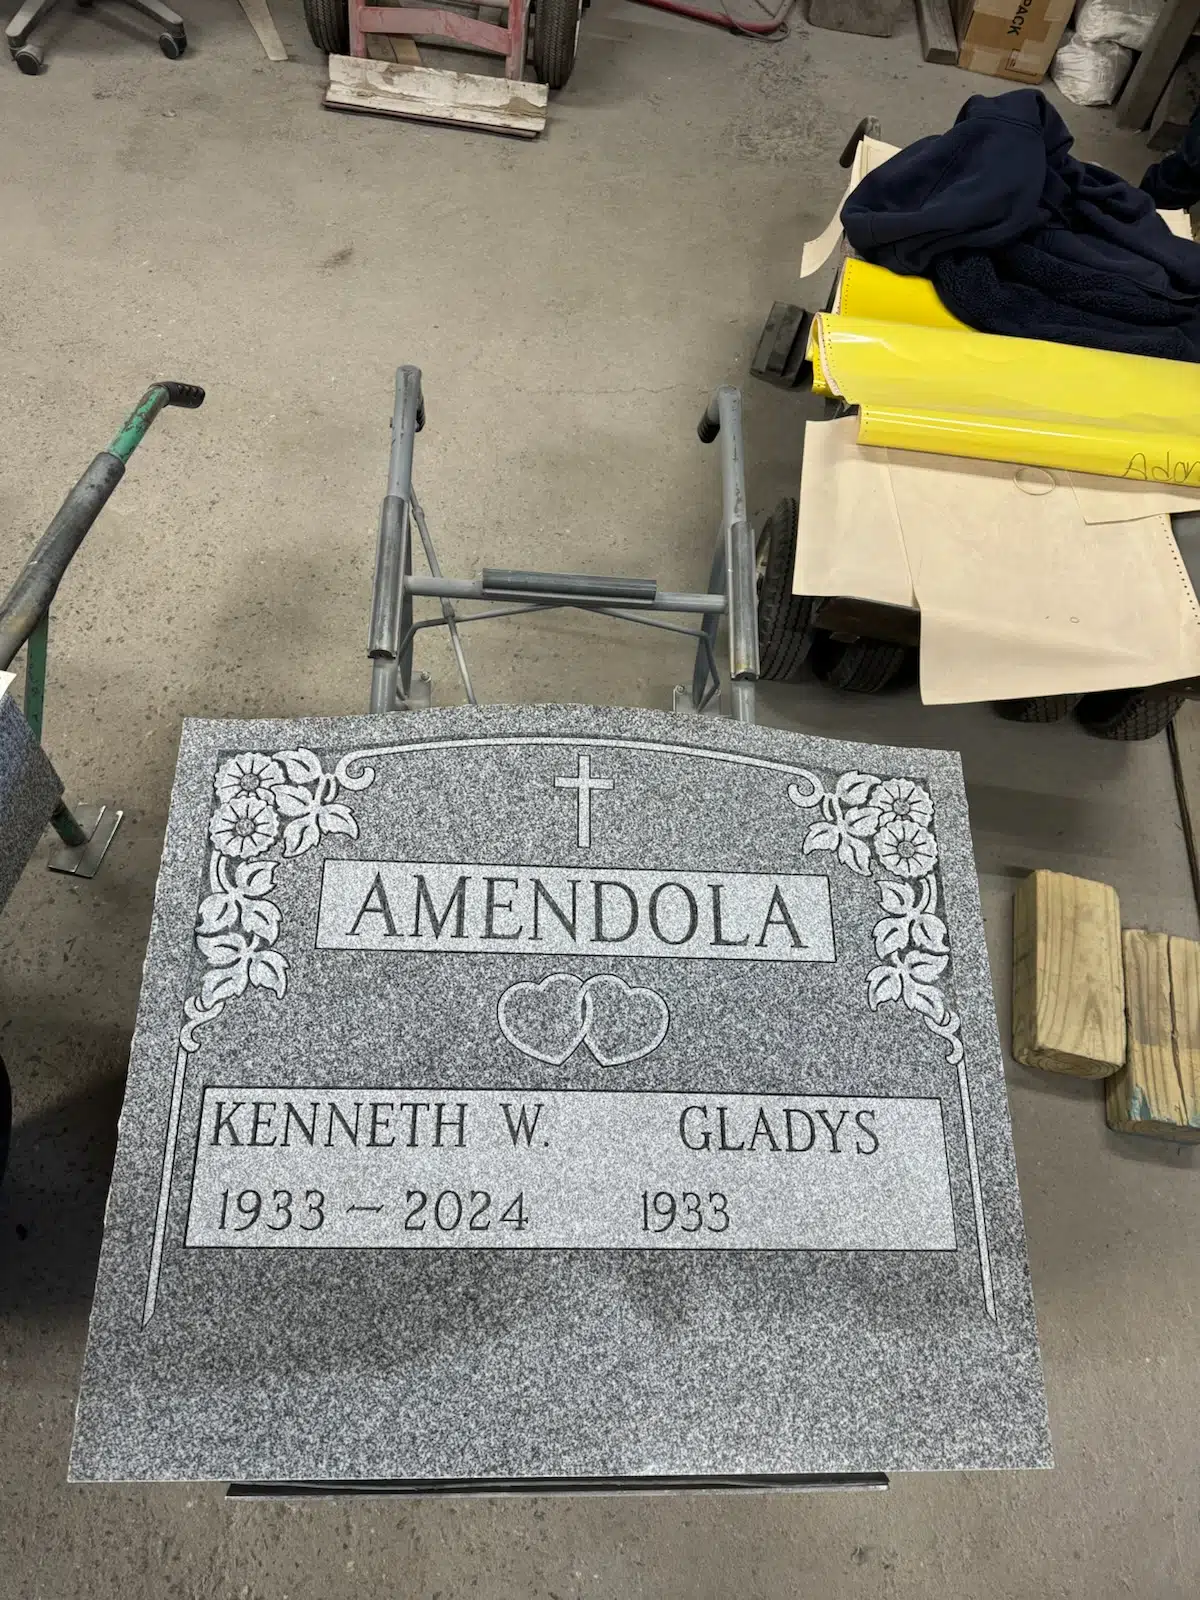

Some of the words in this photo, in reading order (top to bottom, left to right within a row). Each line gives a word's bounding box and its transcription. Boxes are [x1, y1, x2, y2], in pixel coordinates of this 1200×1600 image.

[346, 871, 808, 948] AMENDOLA
[210, 1101, 468, 1147] KENNETH
[500, 1103, 550, 1148] W.
[679, 1105, 880, 1155] GLADYS
[217, 1188, 326, 1232] 1933
[404, 1190, 529, 1232] 2024
[641, 1190, 731, 1233] 1933
